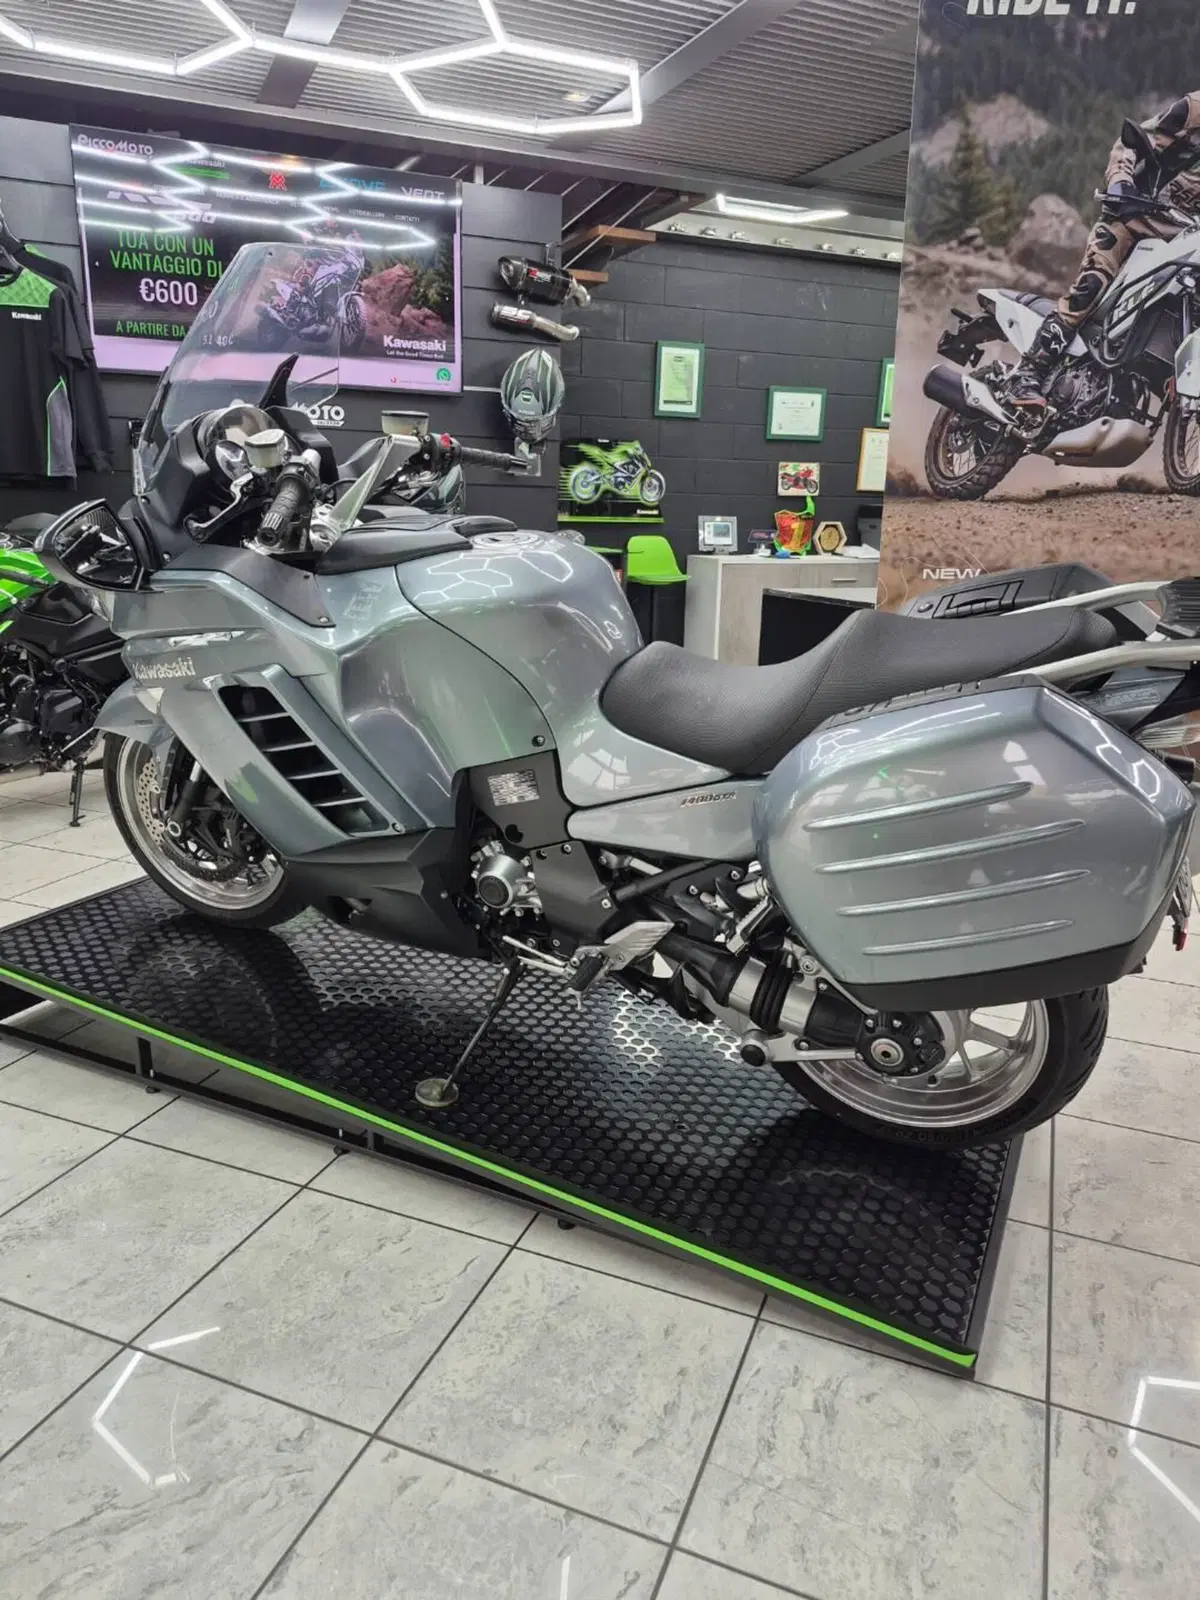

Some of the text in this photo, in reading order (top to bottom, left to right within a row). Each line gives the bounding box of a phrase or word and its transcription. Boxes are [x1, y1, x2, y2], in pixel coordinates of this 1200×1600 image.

[119, 230, 214, 257] TUA CON UN
[110, 250, 223, 278] VANTAGGIO DI
[139, 278, 198, 306] €600
[116, 321, 186, 337] A PARTIRE DA
[383, 335, 447, 352] Kawasaki
[923, 568, 981, 580] NEW
[132, 657, 196, 679] Kawasaki
